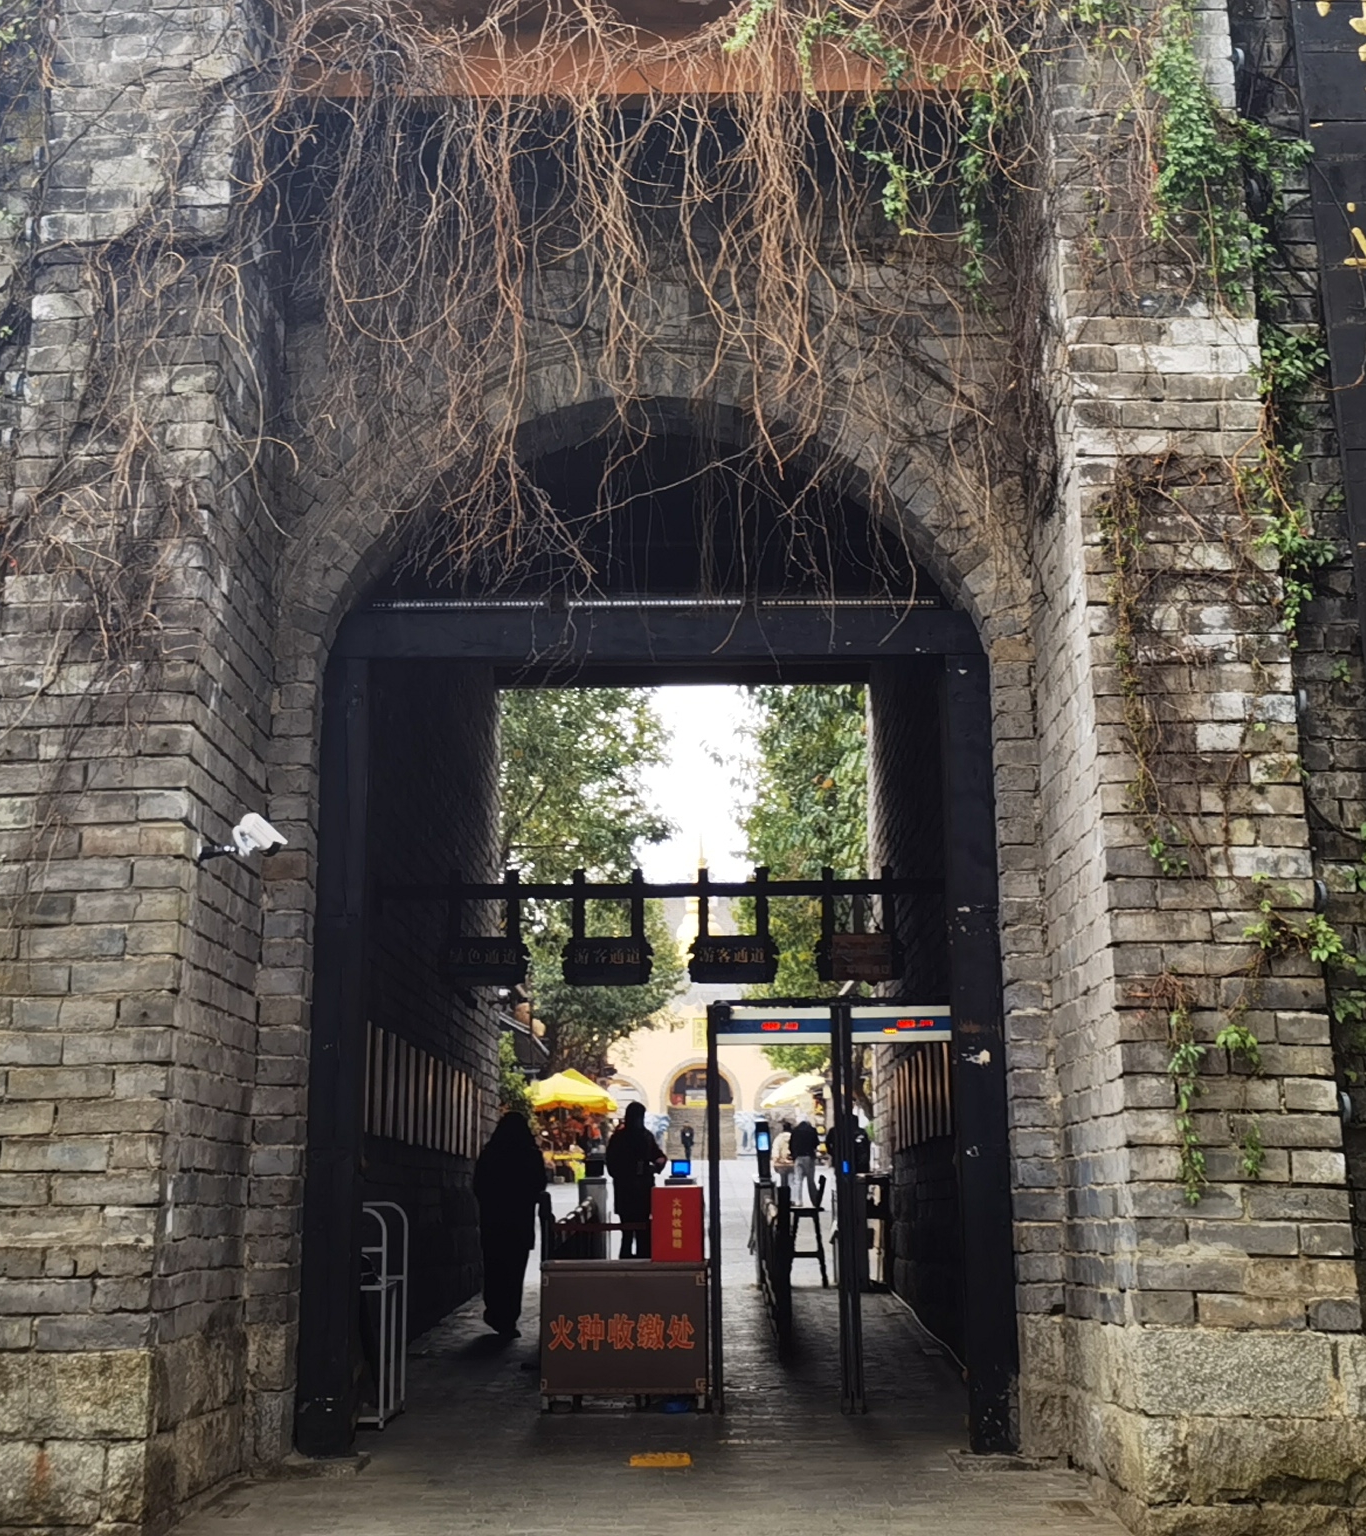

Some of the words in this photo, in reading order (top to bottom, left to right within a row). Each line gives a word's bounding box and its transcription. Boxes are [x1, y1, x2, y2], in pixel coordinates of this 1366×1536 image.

[573, 947, 643, 966] 游客通道
[698, 946, 767, 965] 游客通道
[548, 1313, 696, 1351] 火种收缴处
